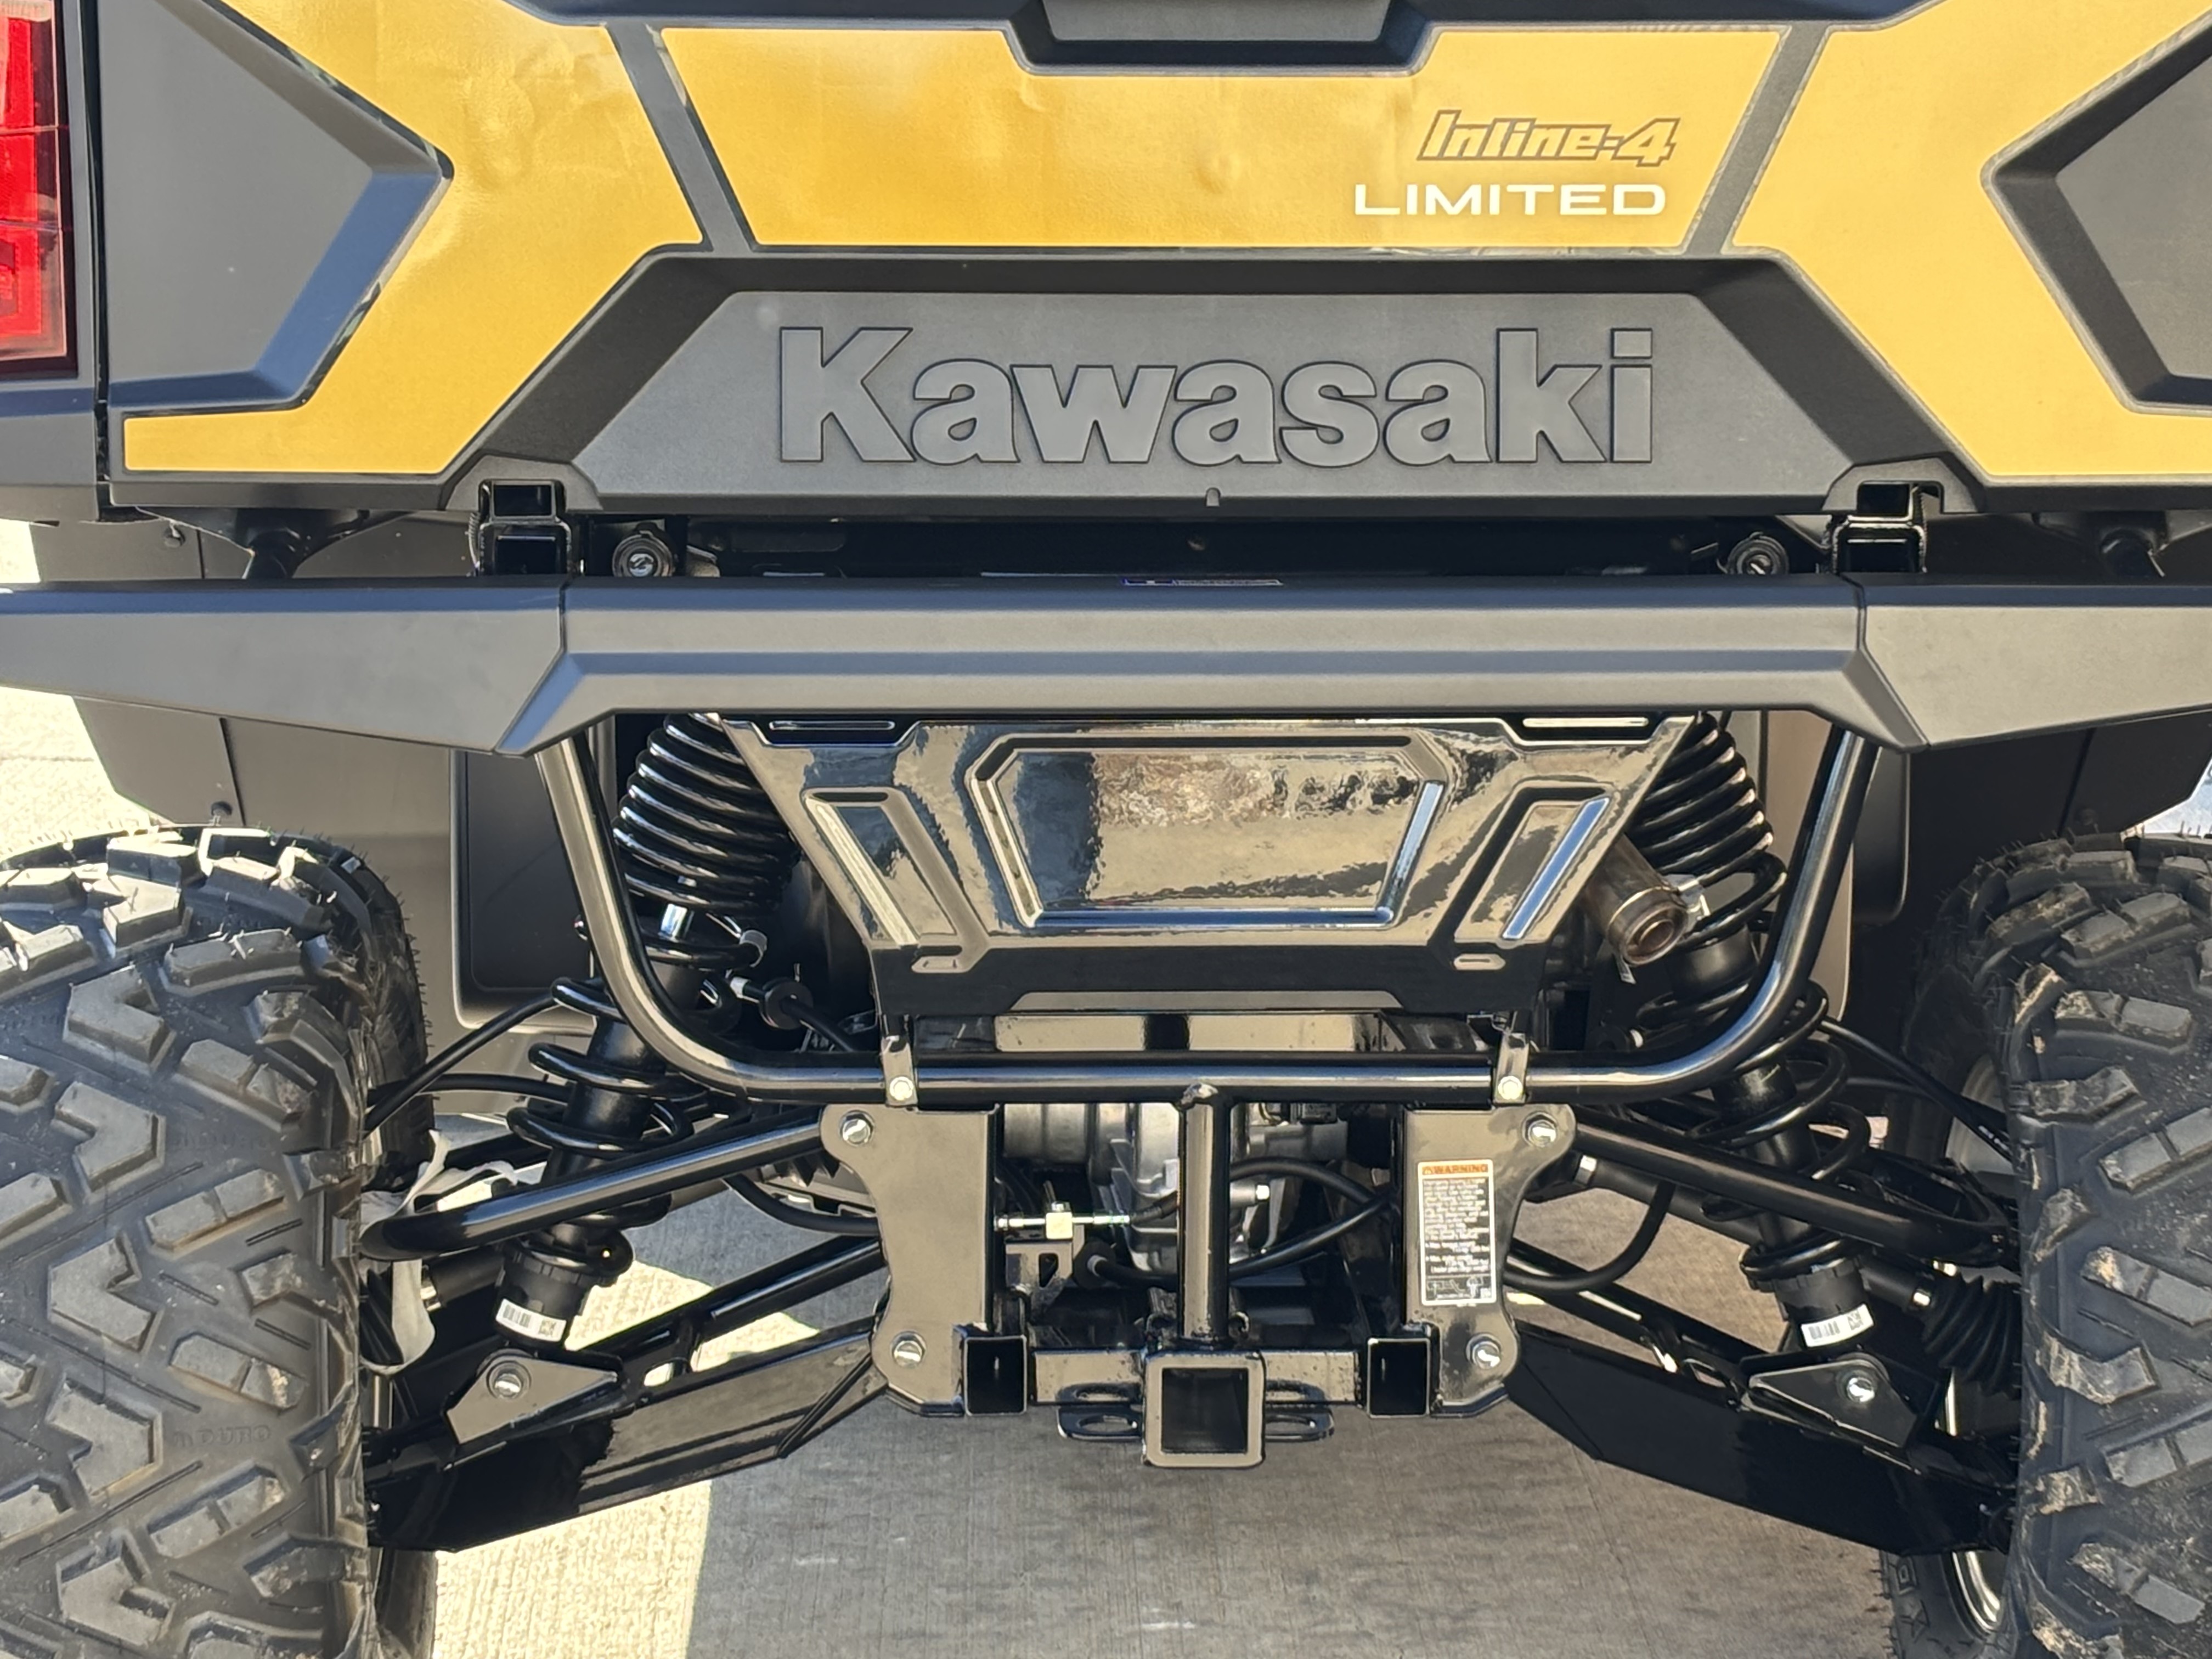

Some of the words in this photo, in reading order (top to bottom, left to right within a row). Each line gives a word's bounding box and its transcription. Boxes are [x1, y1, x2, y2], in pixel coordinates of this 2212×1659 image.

[1417, 109, 1680, 167] Inline-4
[1354, 184, 1666, 216] LIMITED
[778, 326, 1654, 467] Kawasaki
[1434, 1164, 1488, 1175] WARNING
